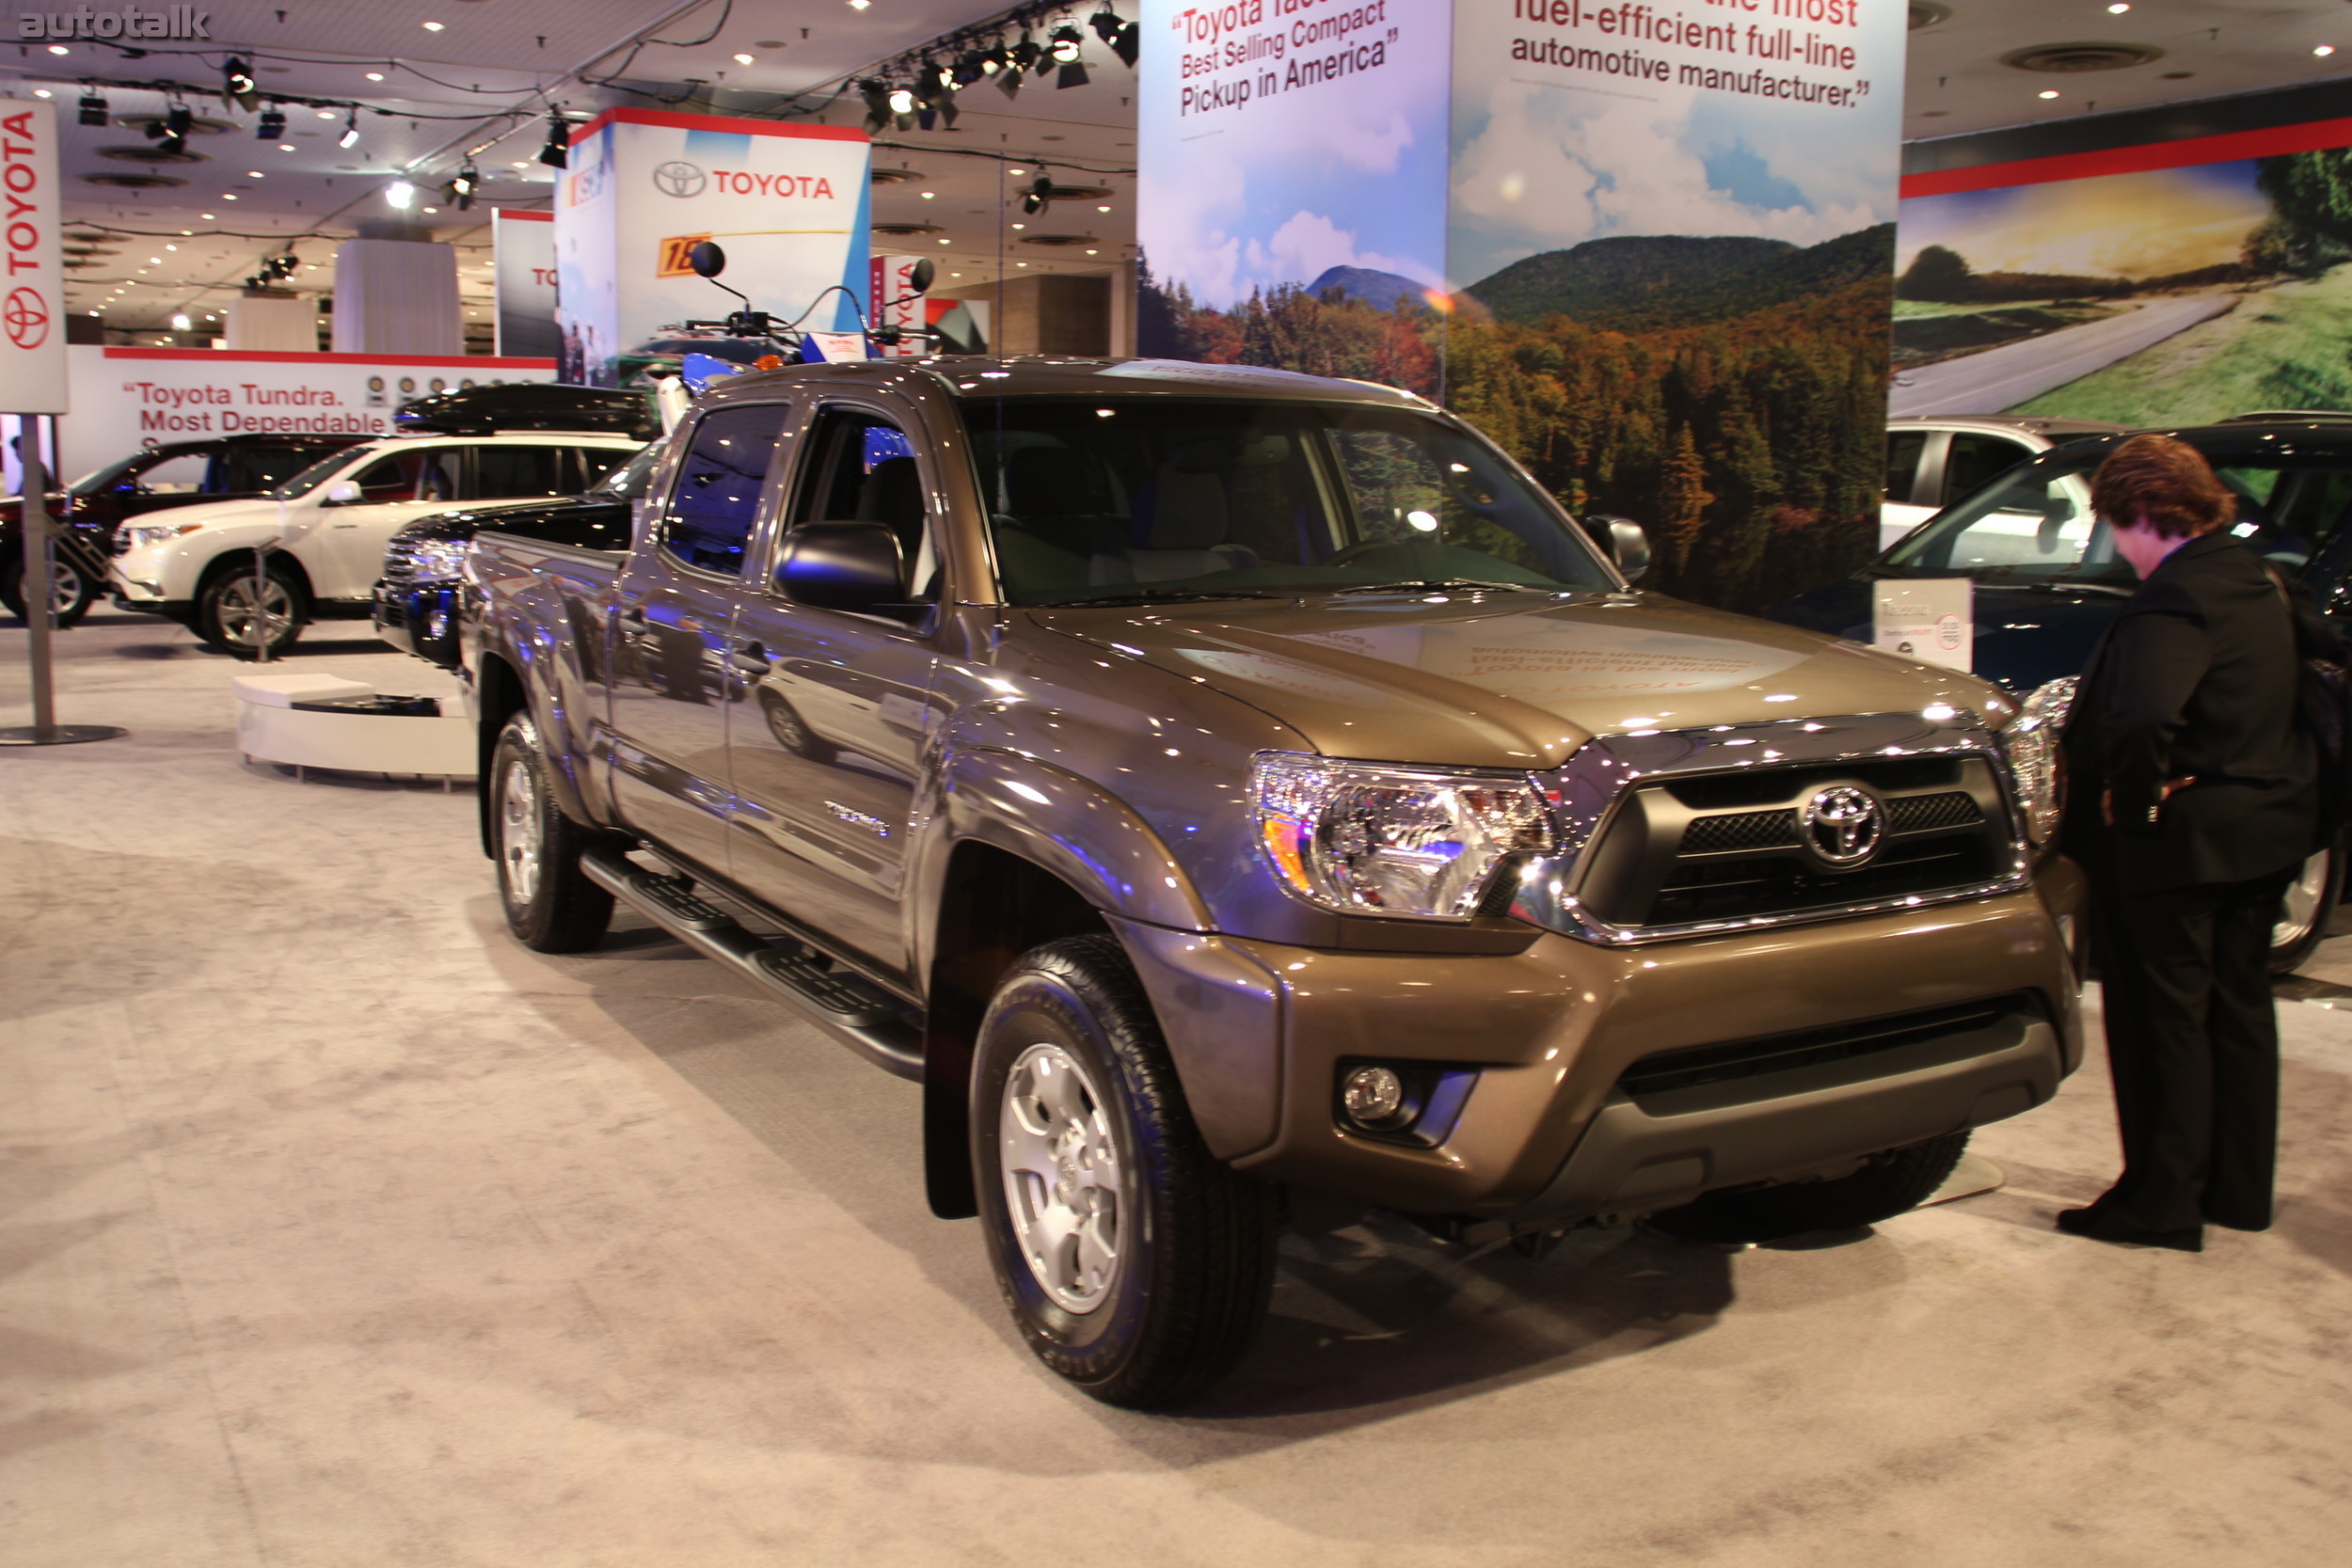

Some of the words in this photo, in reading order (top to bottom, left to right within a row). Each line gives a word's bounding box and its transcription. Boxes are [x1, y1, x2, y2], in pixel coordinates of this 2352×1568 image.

[1182, 48, 1219, 79] Best
[1224, 33, 1285, 60] Selling
[1292, 0, 1386, 48] Compact
[1747, 24, 1856, 70] full-line
[1182, 79, 1251, 117] Pickup
[1258, 67, 1278, 98] in
[1284, 26, 1399, 91] America”
[1512, 38, 1671, 81] automotive
[1678, 64, 1870, 108] manufacturer.”
[2, 111, 40, 277] TOYOTA
[712, 169, 834, 200] TOYOTA
[123, 382, 231, 408] “Toyota
[241, 384, 344, 406] Tundra.
[140, 410, 213, 431] Most
[222, 411, 386, 434] Dependable
